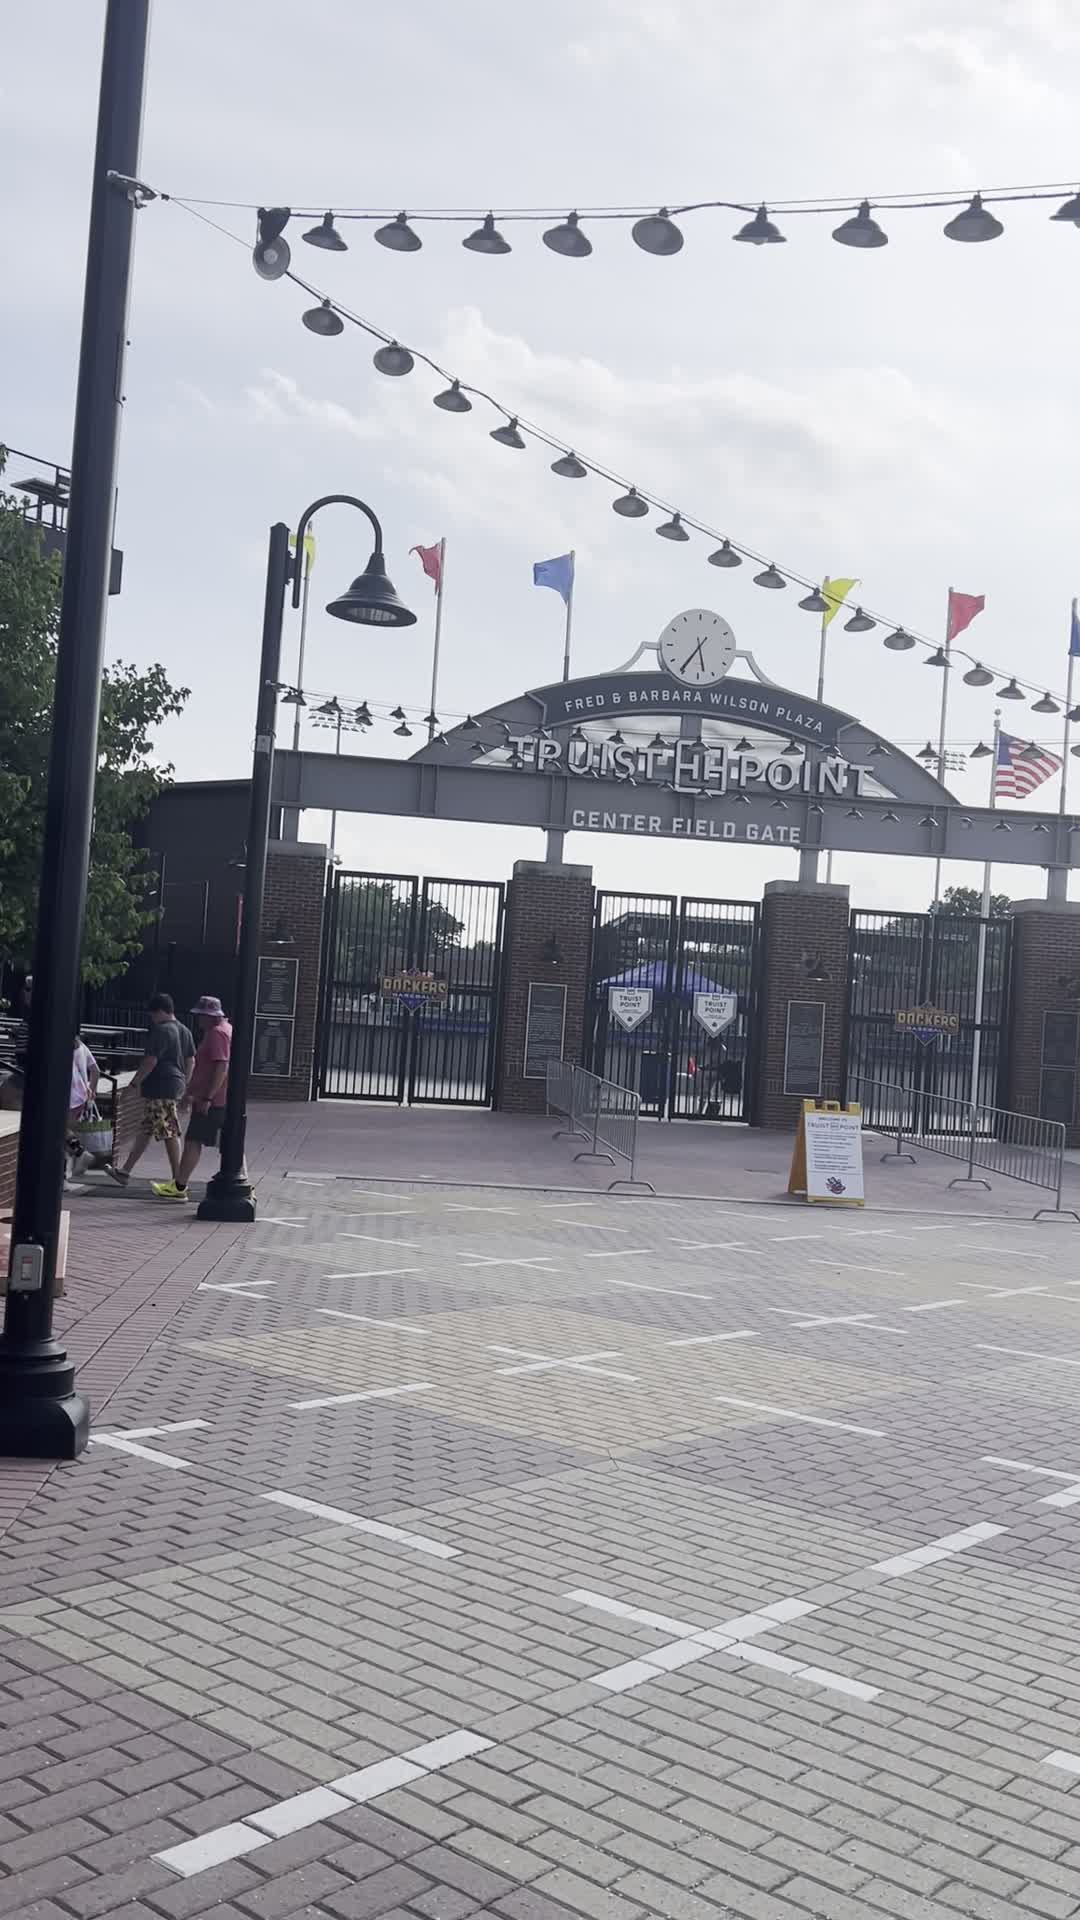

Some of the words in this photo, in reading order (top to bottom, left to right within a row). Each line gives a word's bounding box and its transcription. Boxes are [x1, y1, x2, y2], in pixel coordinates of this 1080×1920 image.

[565, 694, 604, 712] FRED
[612, 692, 621, 703] &
[629, 690, 702, 702] BARBARA
[710, 692, 769, 714] WILSON
[775, 707, 823, 733] PLAZA
[508, 735, 661, 779] TRUIST
[739, 755, 874, 796] POINT
[572, 810, 661, 832] CENTER
[672, 817, 736, 838] FIELD
[746, 823, 801, 843] GATE
